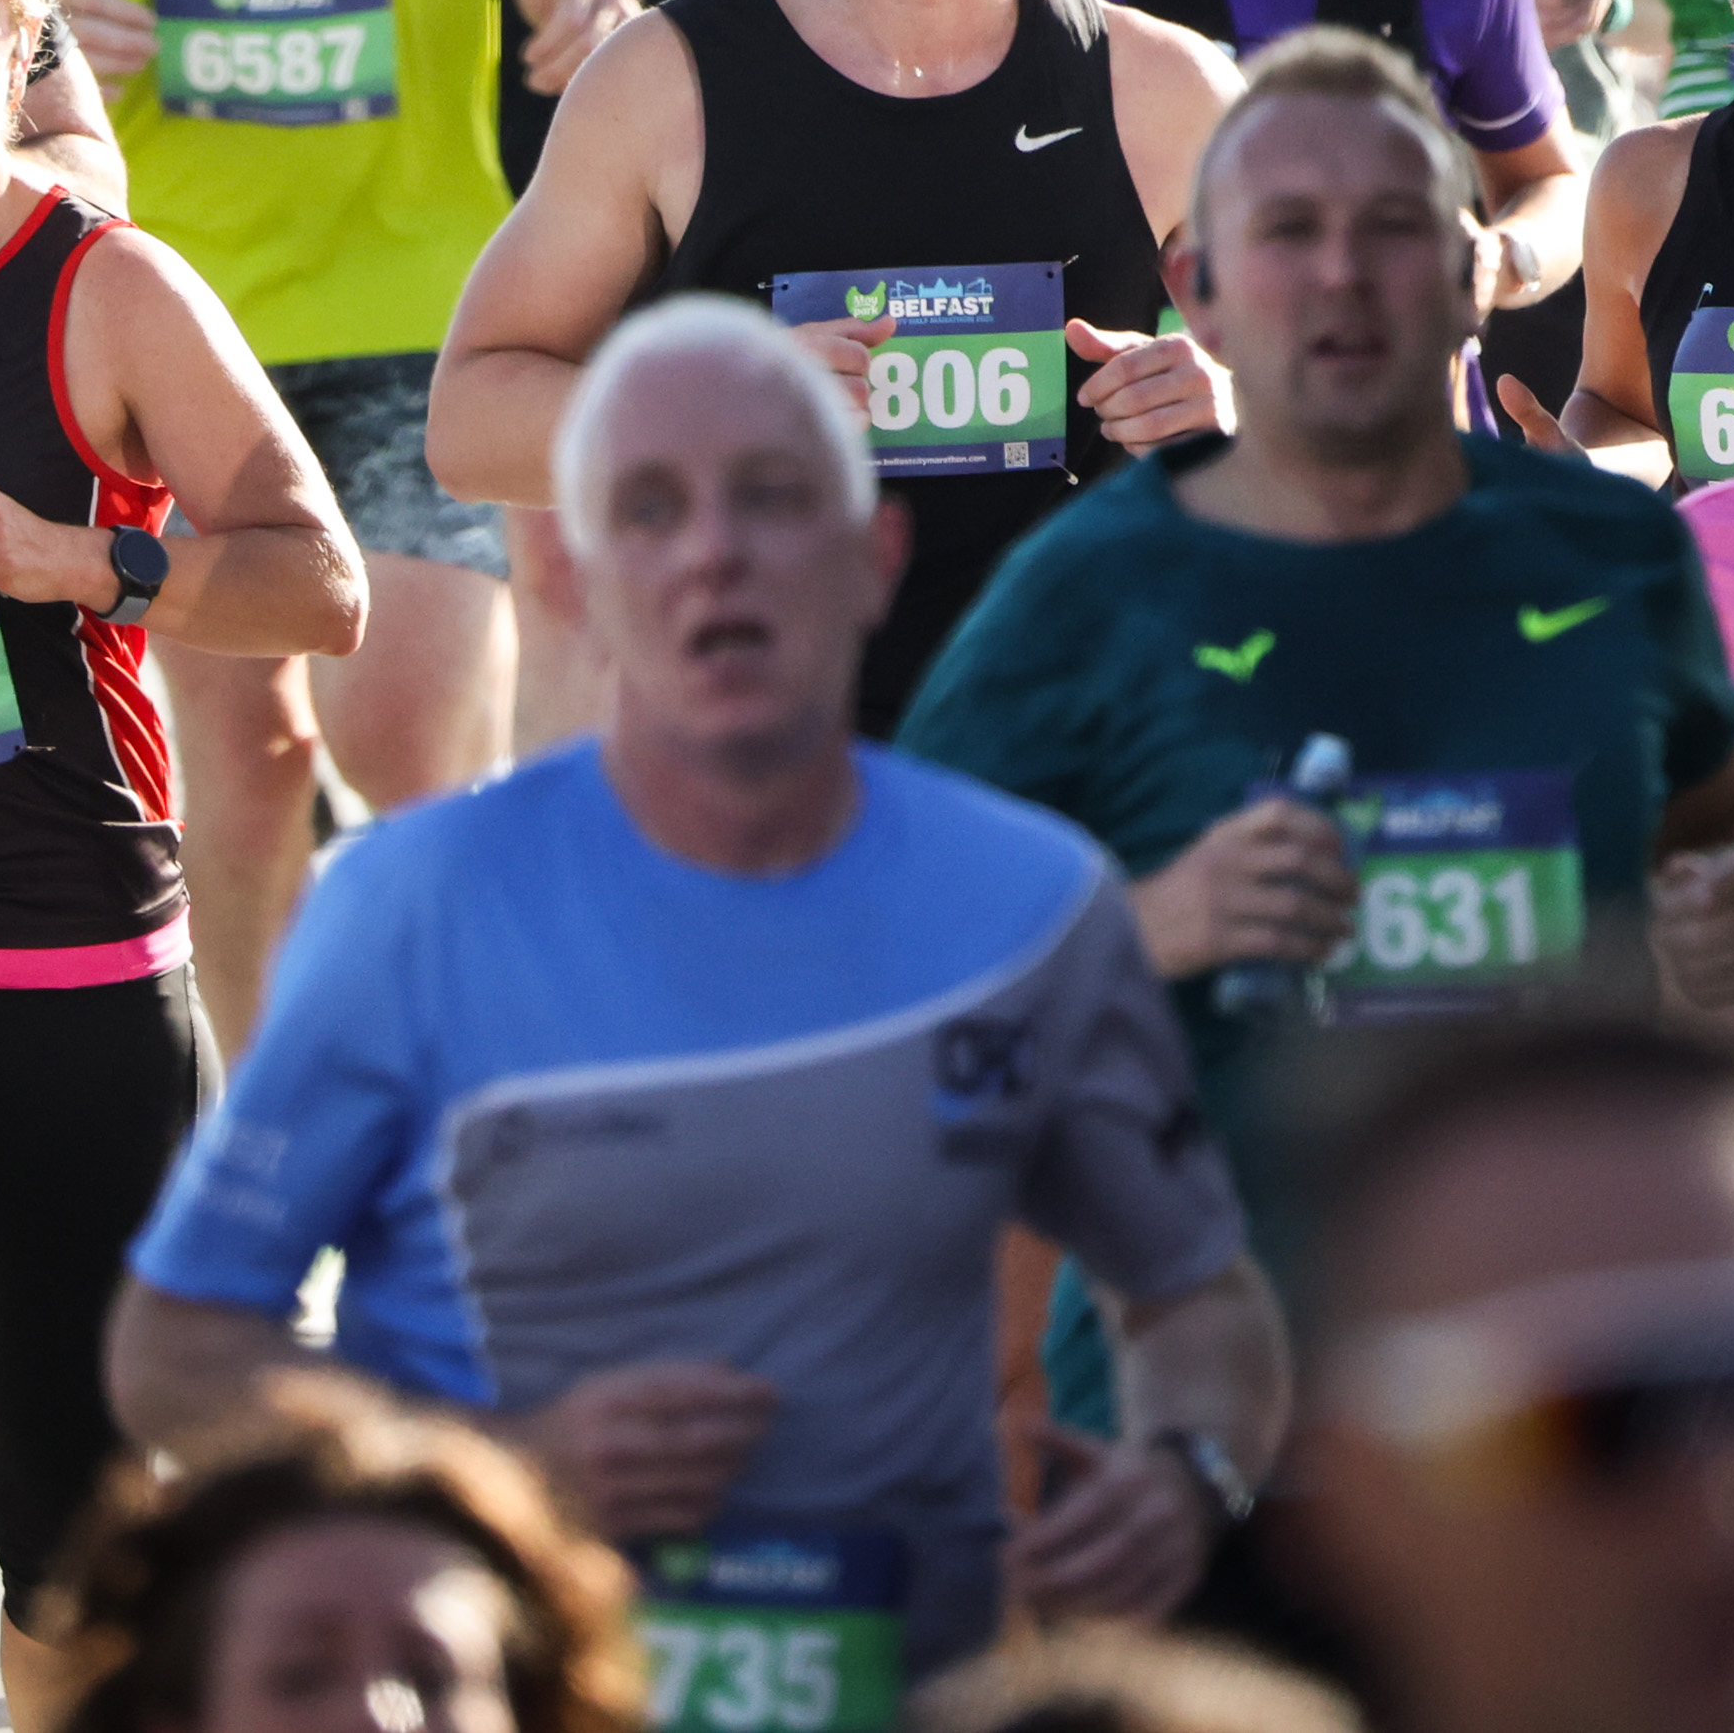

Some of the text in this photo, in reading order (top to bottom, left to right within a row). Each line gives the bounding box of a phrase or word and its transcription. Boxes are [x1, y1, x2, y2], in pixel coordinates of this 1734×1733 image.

[181, 24, 366, 94] 6587
[888, 296, 995, 318] BELFAST
[1326, 867, 1538, 969] 631
[637, 1624, 841, 1730] 735
